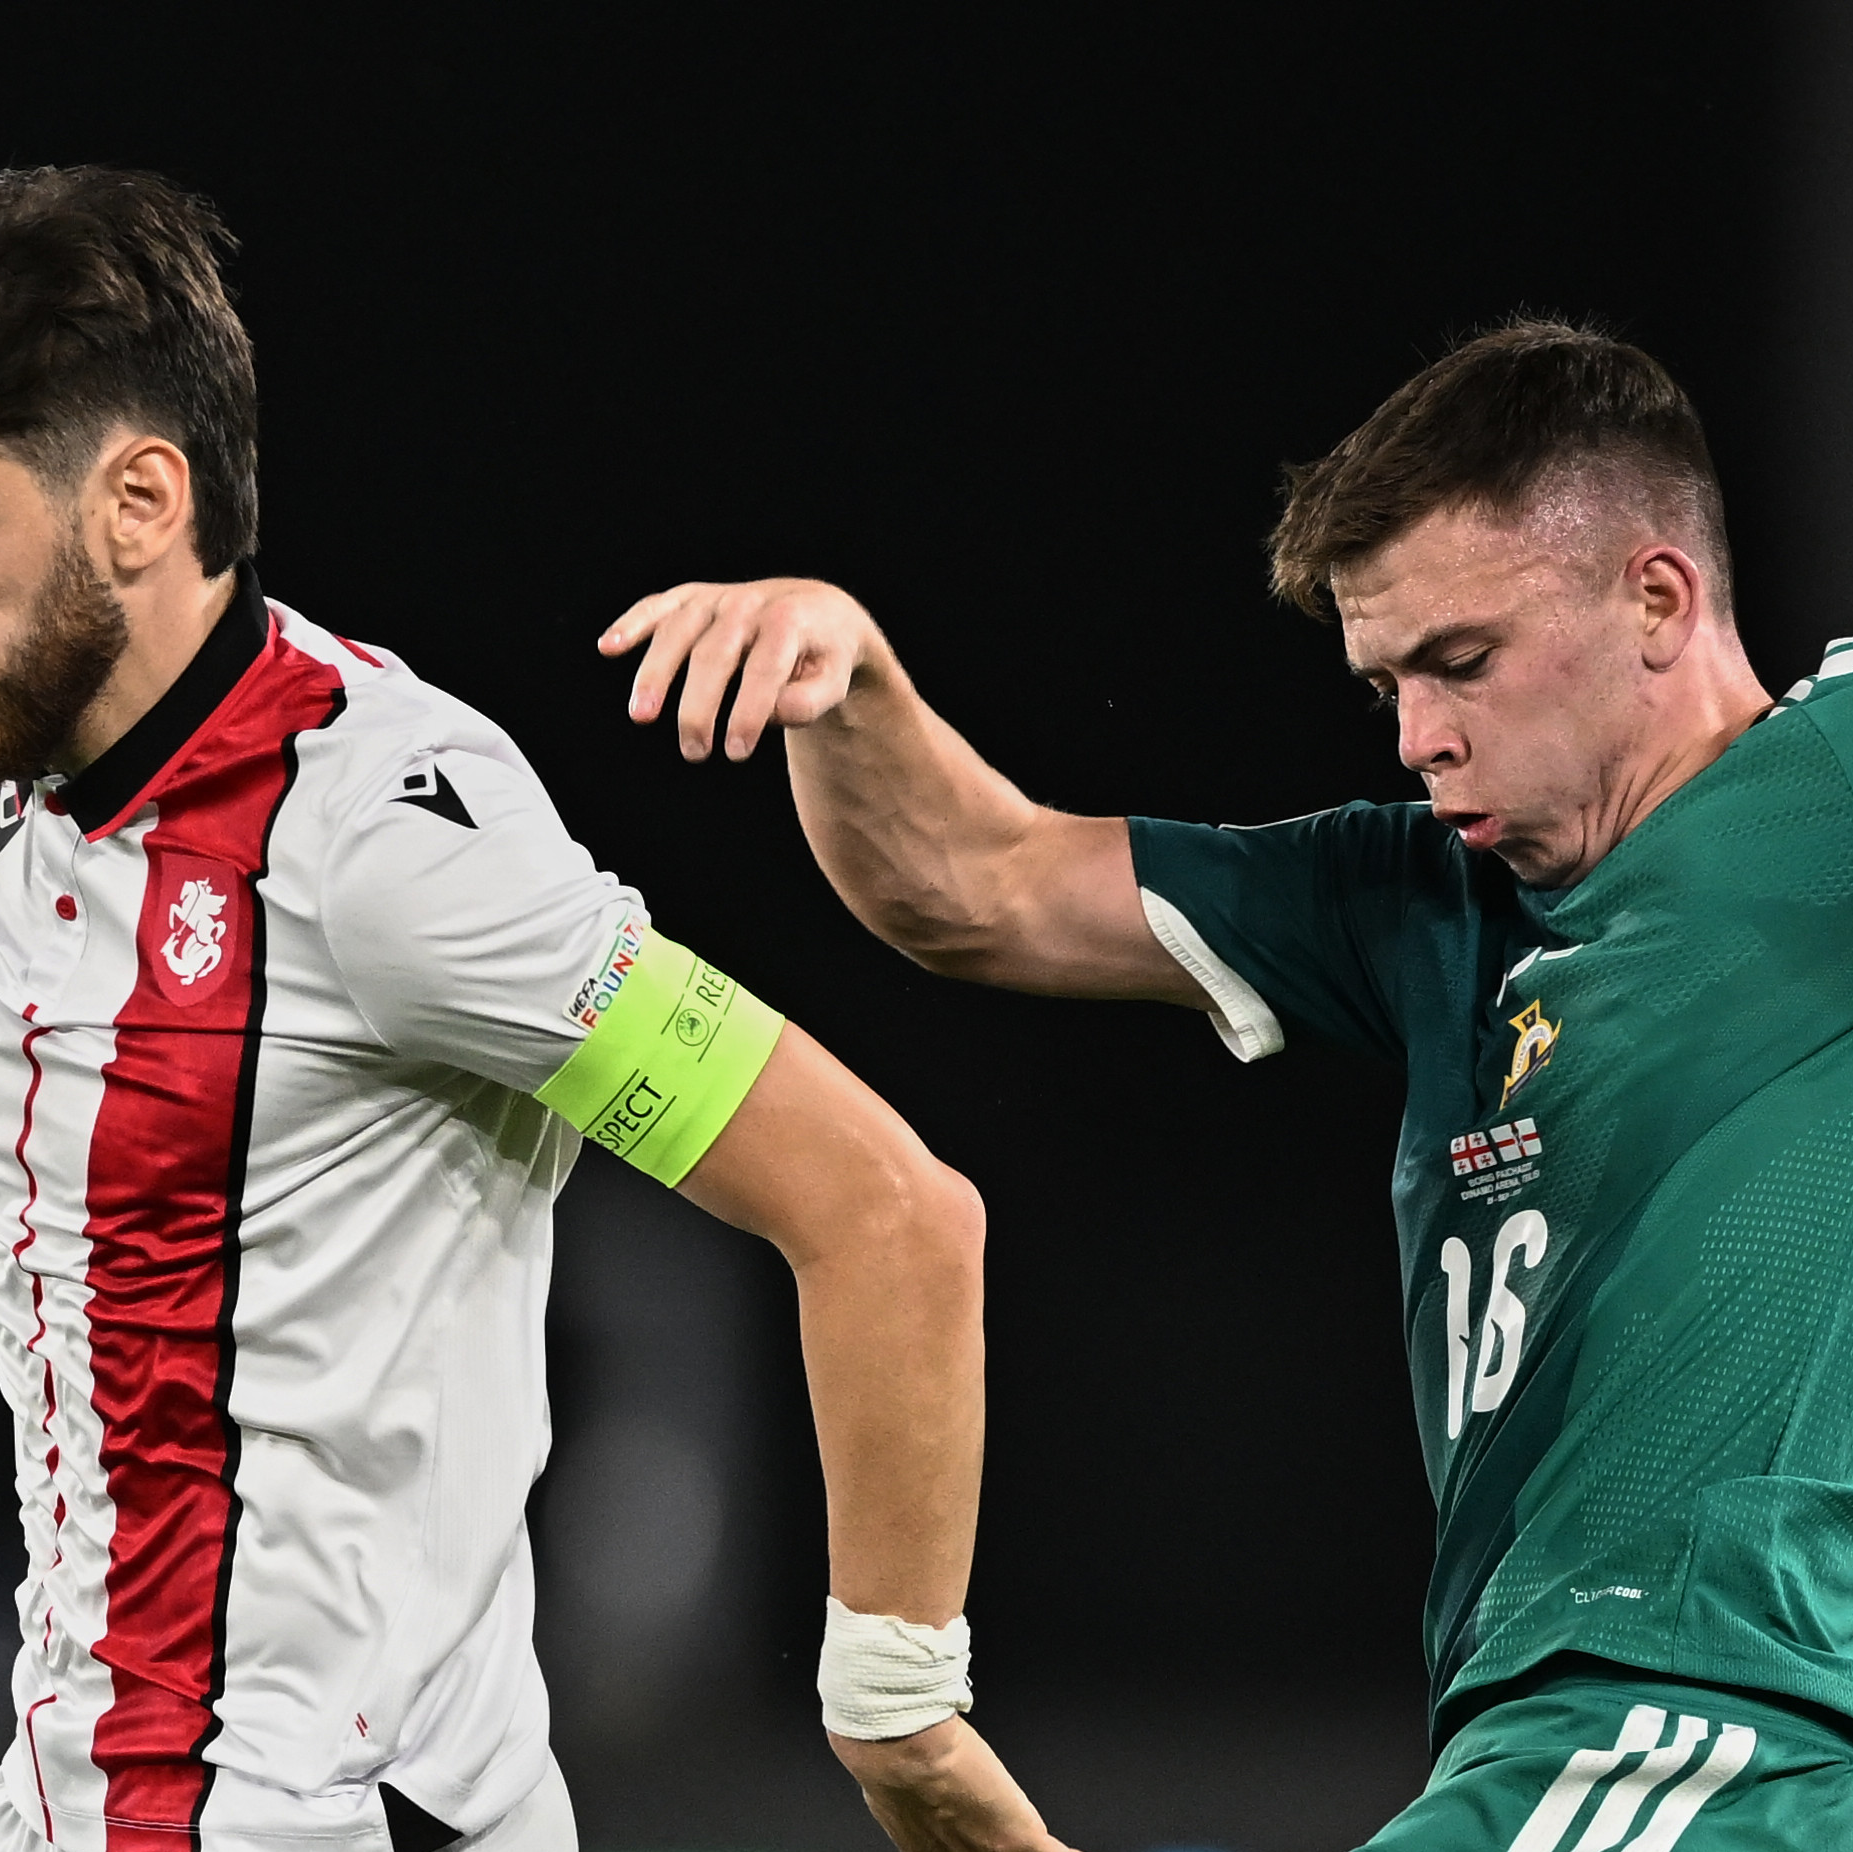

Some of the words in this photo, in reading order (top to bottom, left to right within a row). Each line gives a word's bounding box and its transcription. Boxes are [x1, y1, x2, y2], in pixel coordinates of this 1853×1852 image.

[569, 977, 599, 1018] UEFA
[590, 1076, 663, 1152] SPECT
[1440, 1209, 1548, 1440] 16
